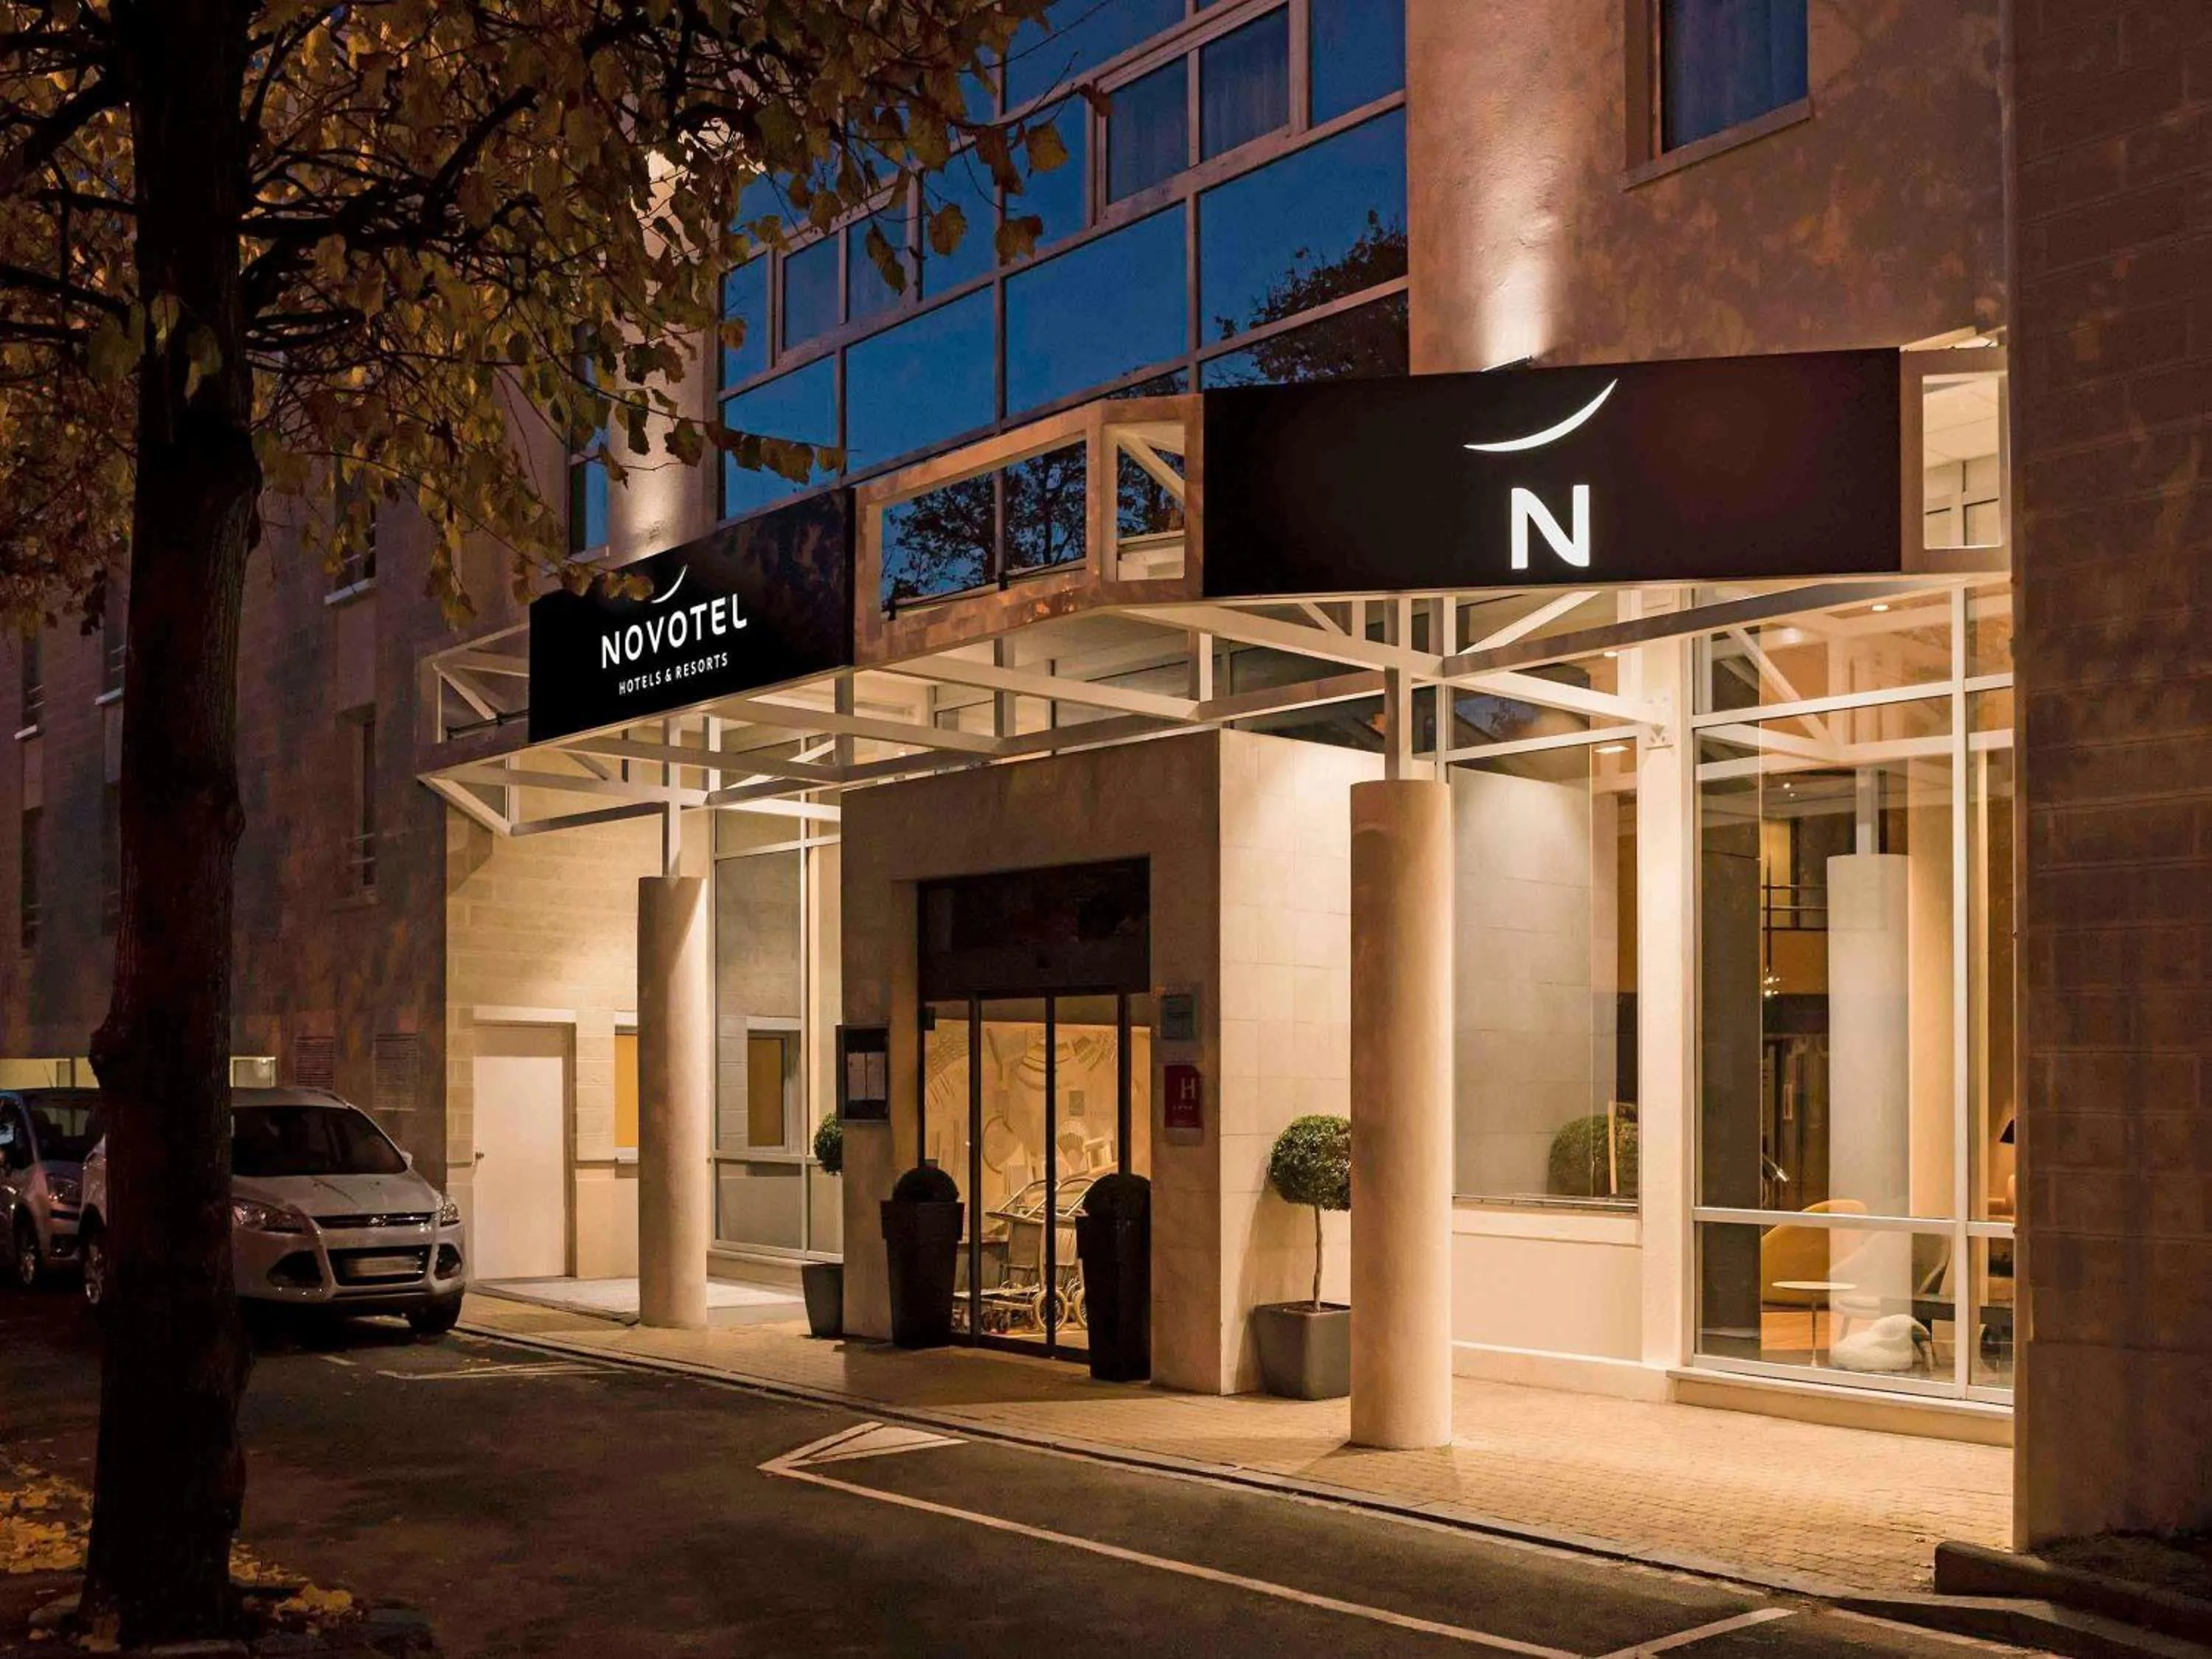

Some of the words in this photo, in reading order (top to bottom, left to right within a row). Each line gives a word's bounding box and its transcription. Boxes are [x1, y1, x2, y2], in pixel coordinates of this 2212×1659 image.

[1510, 484, 1591, 570] N
[601, 593, 748, 669] NOVOTEL
[619, 670, 662, 695] HOTELS
[664, 668, 672, 682] &
[675, 652, 728, 679] RESORTS
[1180, 1077, 1196, 1099] H
